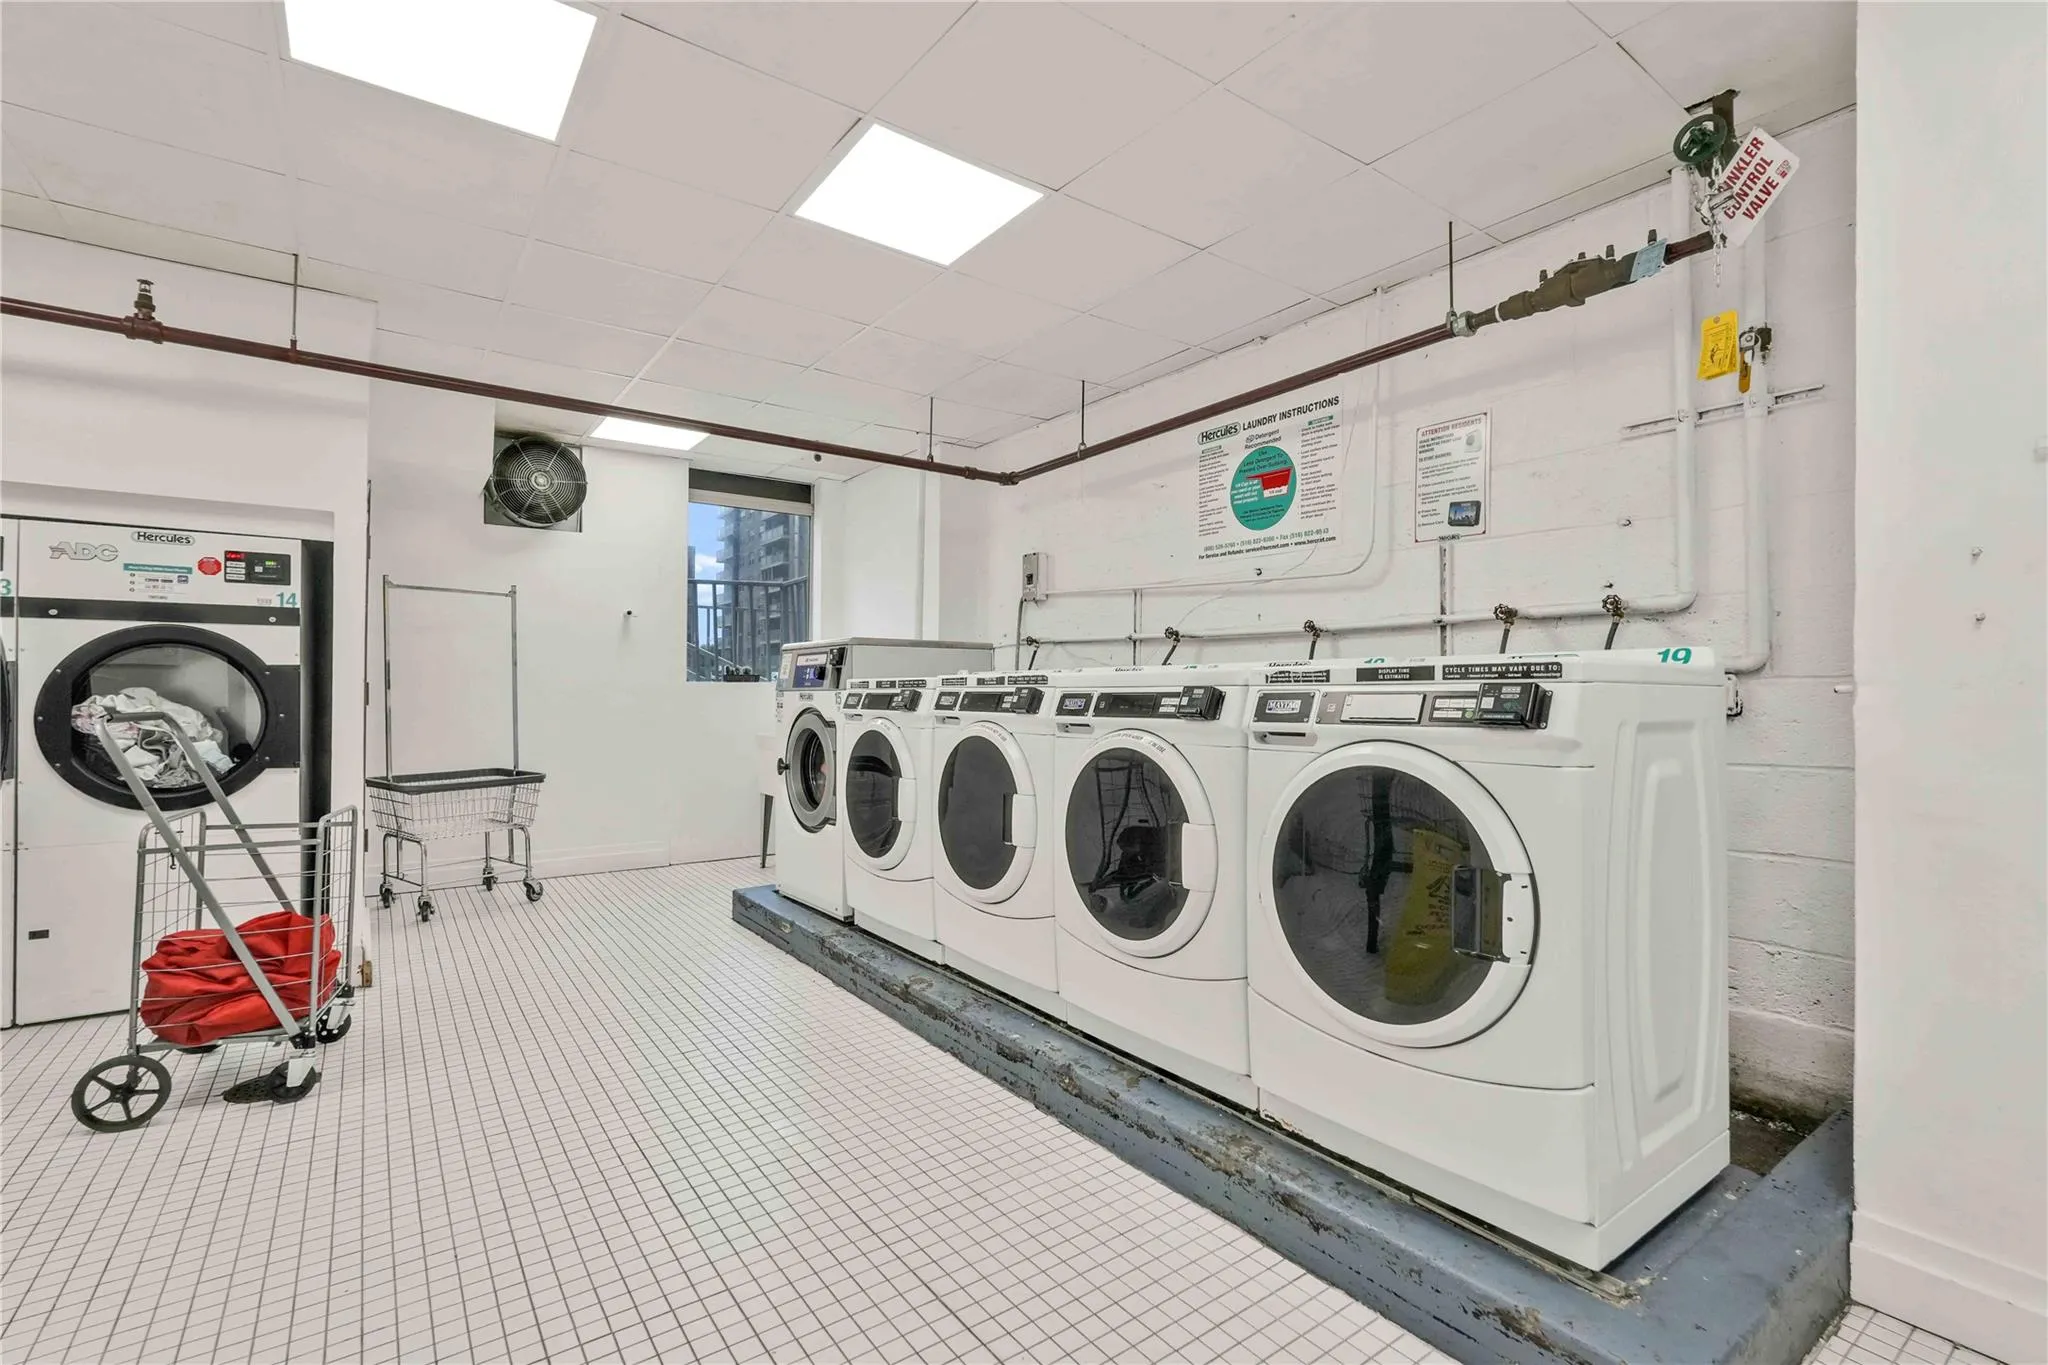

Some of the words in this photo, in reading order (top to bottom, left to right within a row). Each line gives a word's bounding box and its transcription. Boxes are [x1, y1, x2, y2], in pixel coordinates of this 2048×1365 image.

[1718, 137, 1765, 192] INKLER
[1724, 157, 1774, 220] CONTROL
[1742, 176, 1779, 220] VALVE
[1201, 423, 1238, 442] Hercules
[1242, 413, 1277, 431] LAUNDRY
[1279, 396, 1340, 421] INSTRUCTIONS
[1255, 429, 1280, 441] Detergent
[1421, 424, 1450, 436] ATTENTION
[1245, 436, 1282, 450] Recommended
[136, 531, 192, 545] Hercules
[49, 541, 119, 562] ADC
[276, 592, 297, 608] 14
[1657, 647, 1692, 664] 19
[1267, 700, 1301, 709] MAYTAG
